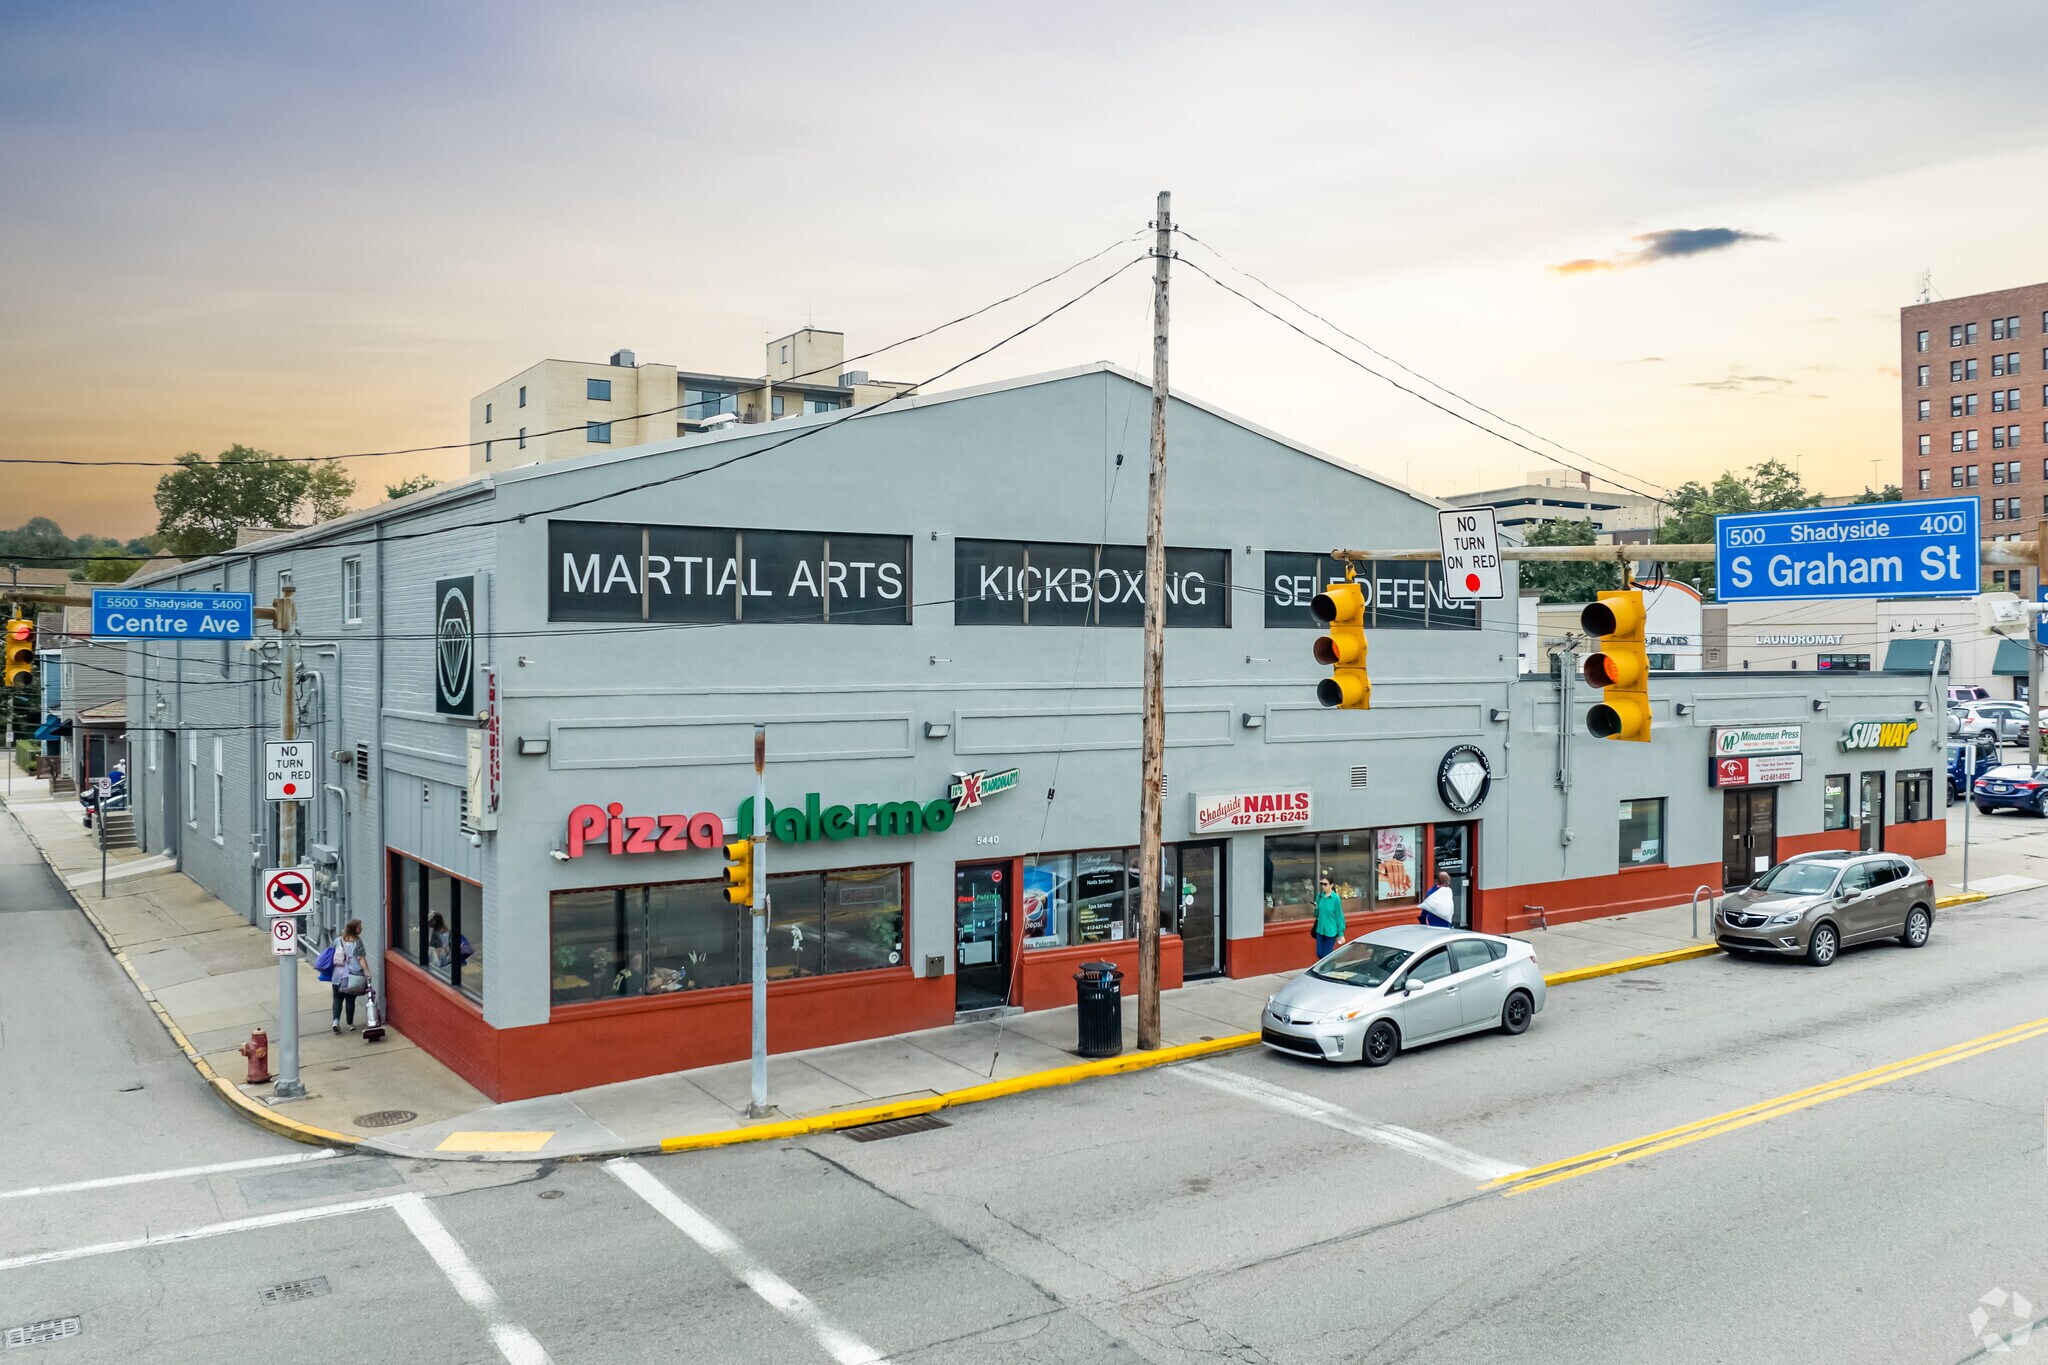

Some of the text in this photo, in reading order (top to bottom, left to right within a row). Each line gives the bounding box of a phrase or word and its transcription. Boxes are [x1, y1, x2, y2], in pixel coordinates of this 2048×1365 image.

[1457, 516, 1476, 532] NO
[1730, 514, 1963, 546] 500 Shadyside 400
[1453, 536, 1485, 551] TURN
[1447, 555, 1497, 569] ON RED
[1731, 545, 1962, 588] S Graham St
[563, 552, 903, 599] MARTIAL ARTS
[980, 565, 1206, 605] KICKBOXNG
[1360, 578, 1476, 610] DEFEN
[106, 598, 242, 610] 5500 Shadyside 5400
[106, 613, 240, 633] Centre Ave
[1651, 636, 1689, 646] PILATES
[1755, 635, 1843, 646] LAUNDROMAT
[1740, 729, 1799, 741] Minuteman Press
[1845, 722, 1918, 749] SUBWAY
[281, 746, 298, 757] NO
[276, 759, 304, 769] TURN
[1451, 745, 1482, 757] MARTIAL
[1481, 756, 1491, 779] ARTS
[268, 770, 311, 781] ON RED
[1825, 786, 1842, 795] Open
[1199, 792, 1309, 825] Shadyside NAILS
[1449, 798, 1483, 813] ACADEMY
[567, 792, 956, 858] Pizza Palermo
[1231, 811, 1309, 825] 412 621-6245
[976, 835, 1000, 845] 5440
[1642, 848, 1657, 856] OPEN
